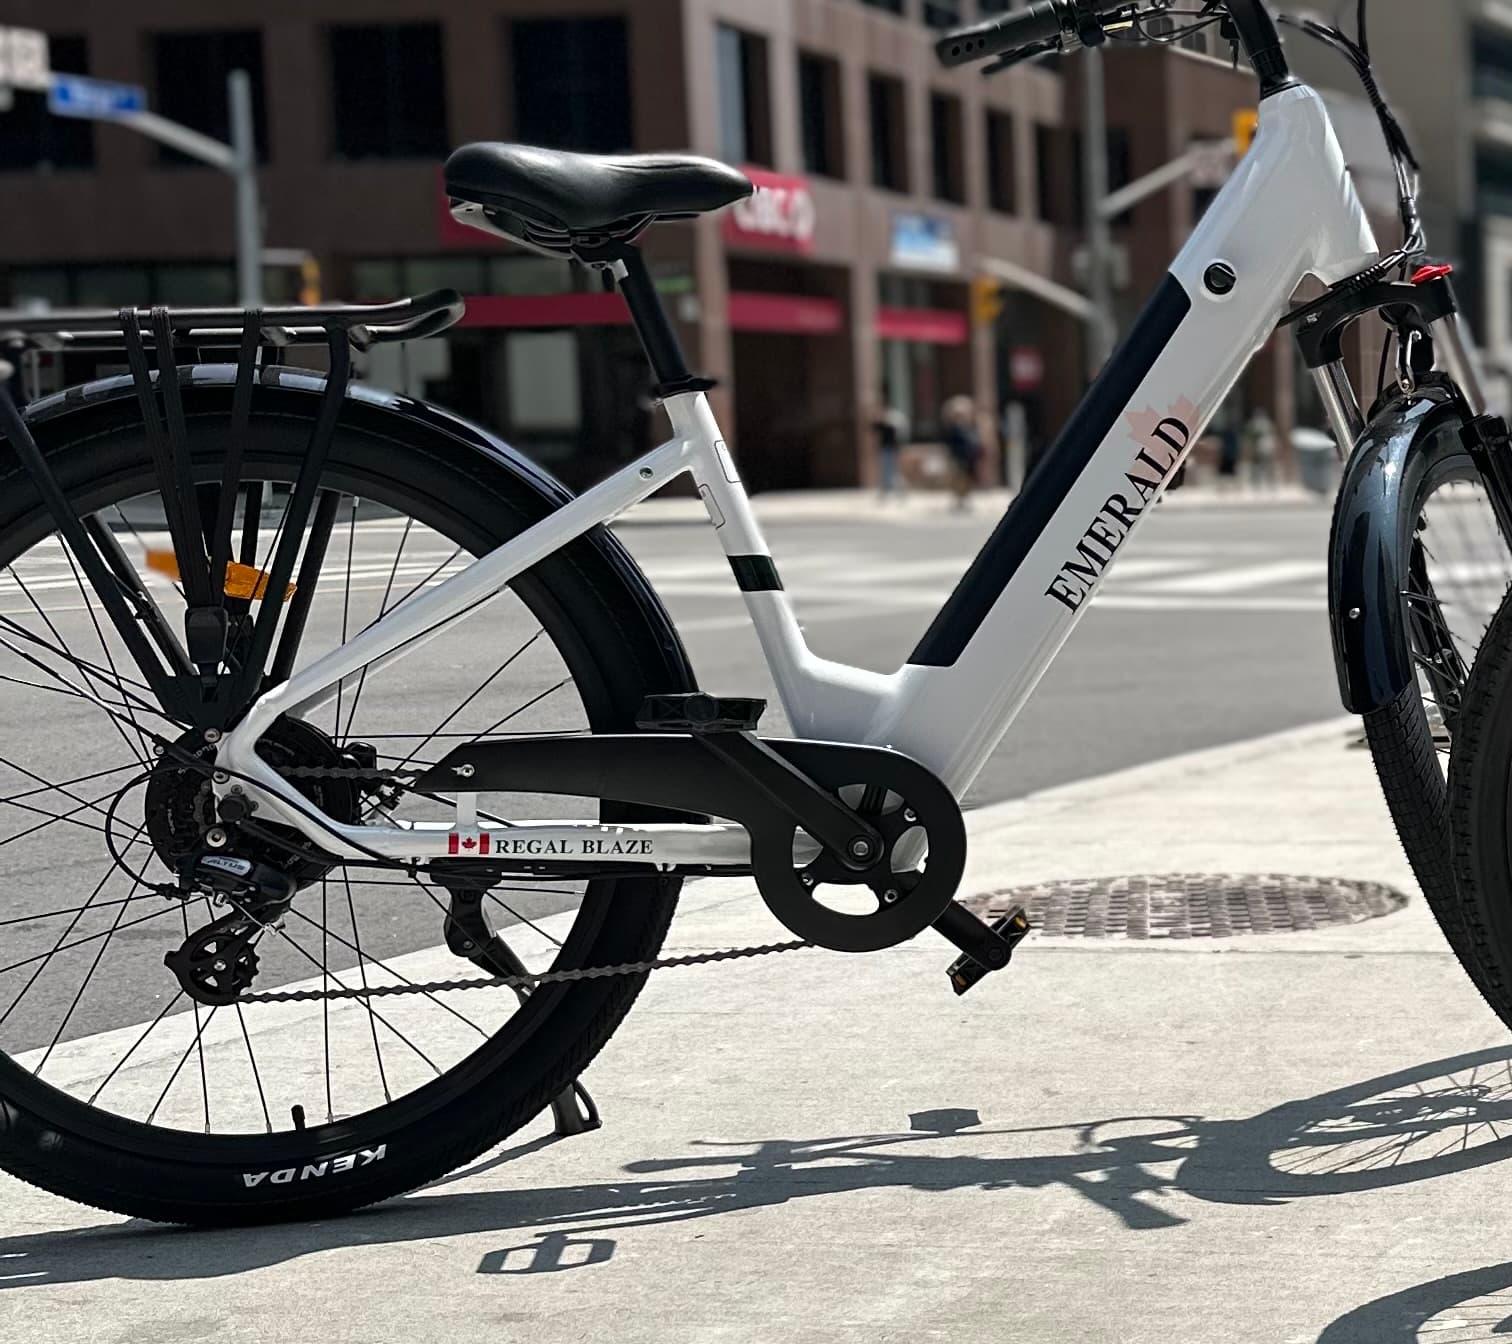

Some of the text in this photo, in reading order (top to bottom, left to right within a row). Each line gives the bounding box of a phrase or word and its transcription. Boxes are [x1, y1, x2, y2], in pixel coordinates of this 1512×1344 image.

[1044, 417, 1190, 615] EMERALD
[495, 839, 654, 855] REGAL BLAZE
[243, 1143, 387, 1187] KENDA
